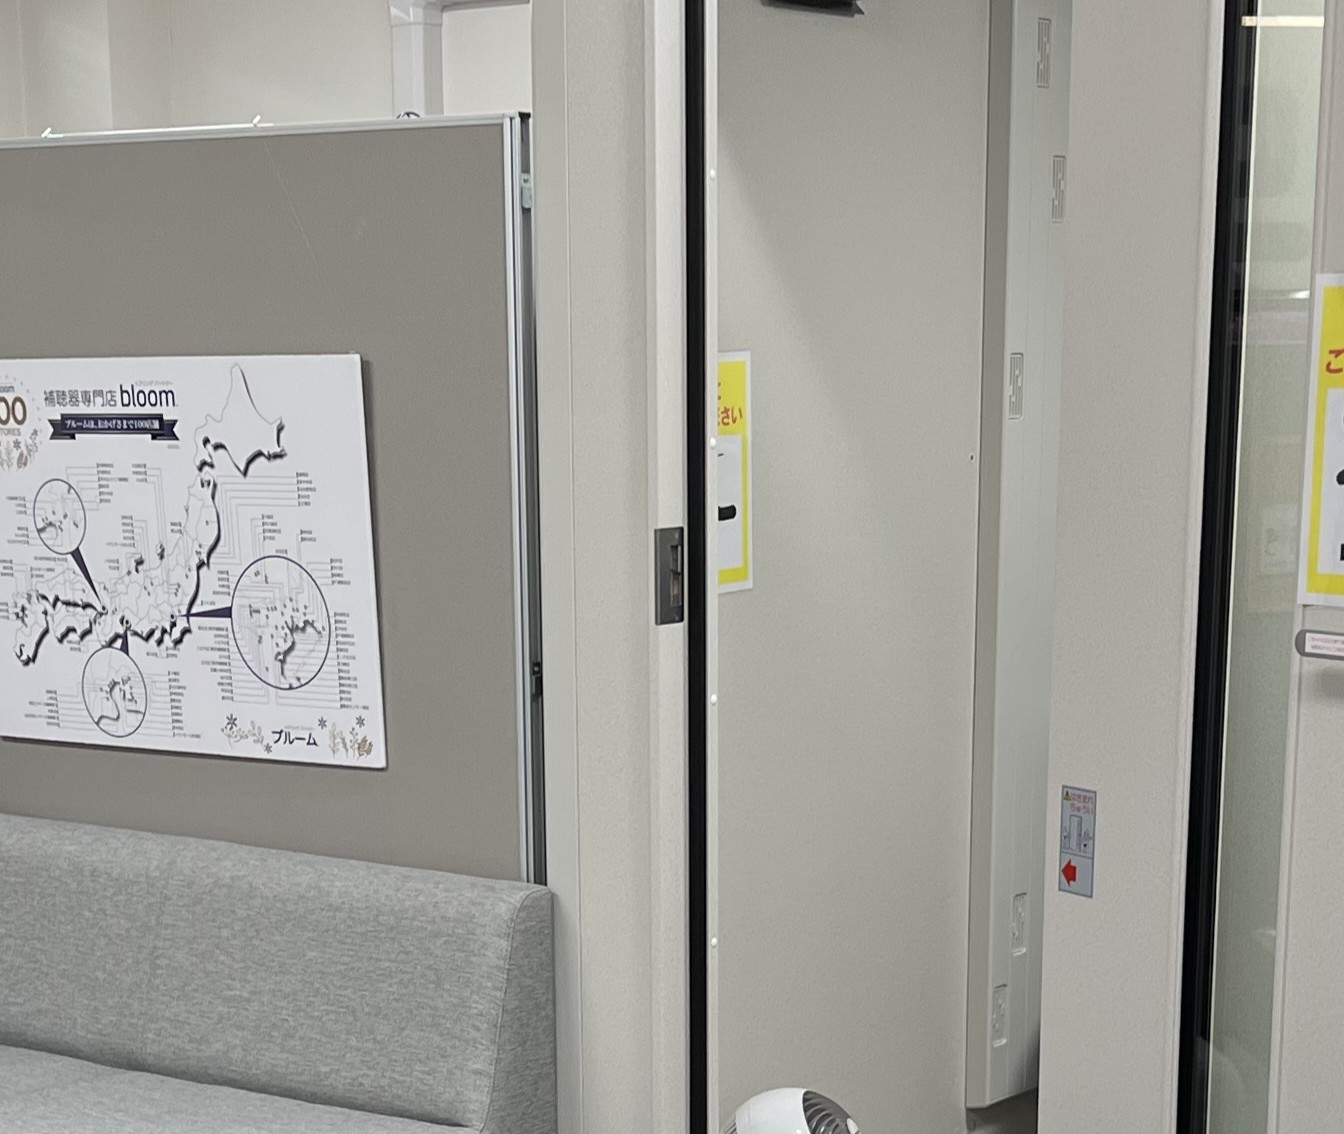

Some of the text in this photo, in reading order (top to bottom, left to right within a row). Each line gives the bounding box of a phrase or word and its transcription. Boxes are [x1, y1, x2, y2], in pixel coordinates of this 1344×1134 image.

[43, 384, 176, 408] 補聴器専門店 bloom
[271, 729, 318, 747] ブルーム
